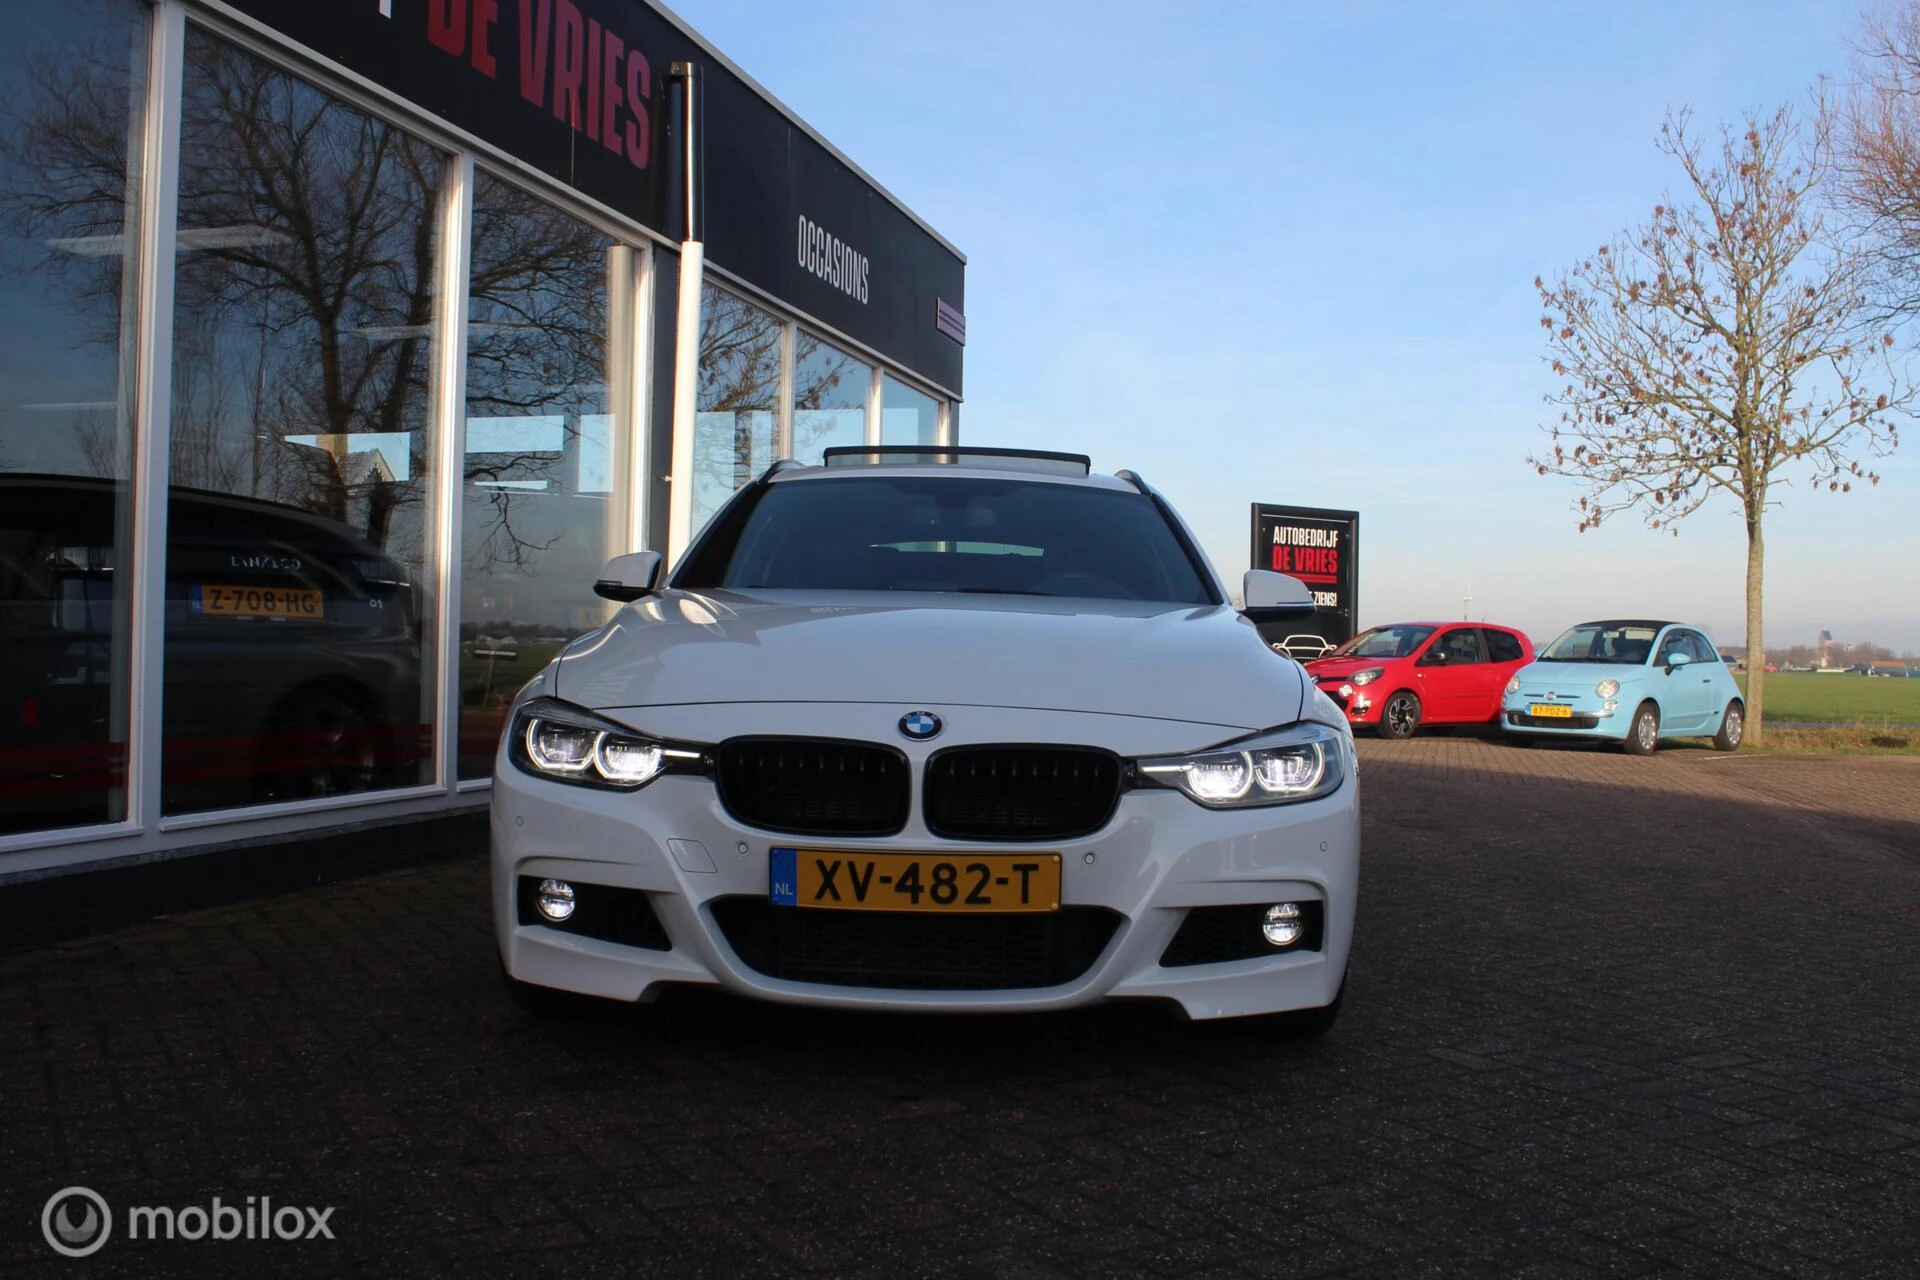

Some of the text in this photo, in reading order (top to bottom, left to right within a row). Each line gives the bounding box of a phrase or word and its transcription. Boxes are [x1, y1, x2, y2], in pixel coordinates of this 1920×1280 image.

[518, 0, 650, 169] VRIES
[798, 214, 869, 305] OCCASIONS
[1273, 526, 1338, 548] AUTOBEDRIJF
[1272, 545, 1338, 574] DE VRIES
[209, 589, 316, 614] Z-708-HG
[1313, 591, 1338, 607] ZIENS!
[775, 858, 1040, 905] NL XV-482-T
